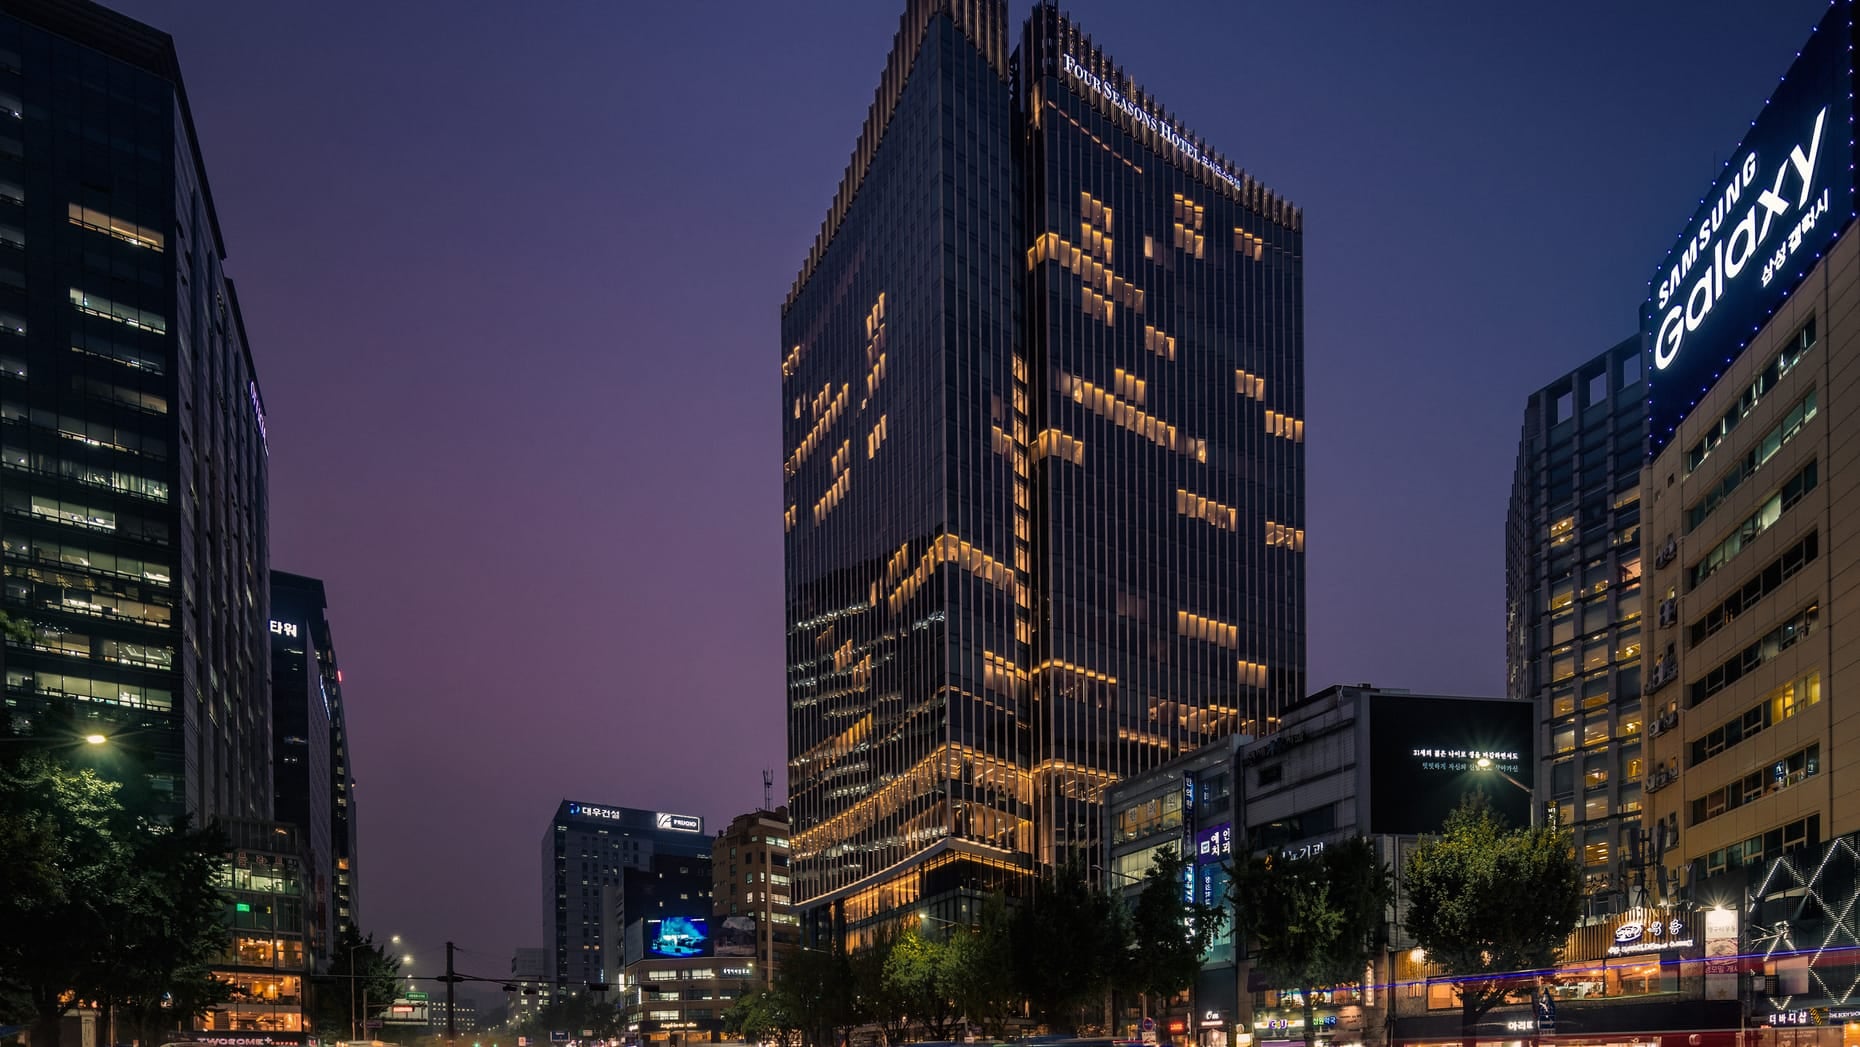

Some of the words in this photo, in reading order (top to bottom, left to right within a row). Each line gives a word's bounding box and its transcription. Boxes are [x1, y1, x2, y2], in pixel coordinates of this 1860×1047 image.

[1063, 53, 1102, 94] FOUR
[1102, 79, 1158, 132] SEASONS
[1159, 120, 1201, 163] HOTEL
[1655, 105, 1827, 371] Galaxy
[1658, 152, 1757, 309] SAMSUNG
[1761, 240, 1787, 288] 삼성
[1788, 188, 1829, 255] 갤럭시
[270, 620, 297, 638] 타워
[581, 806, 621, 820] 대우건설
